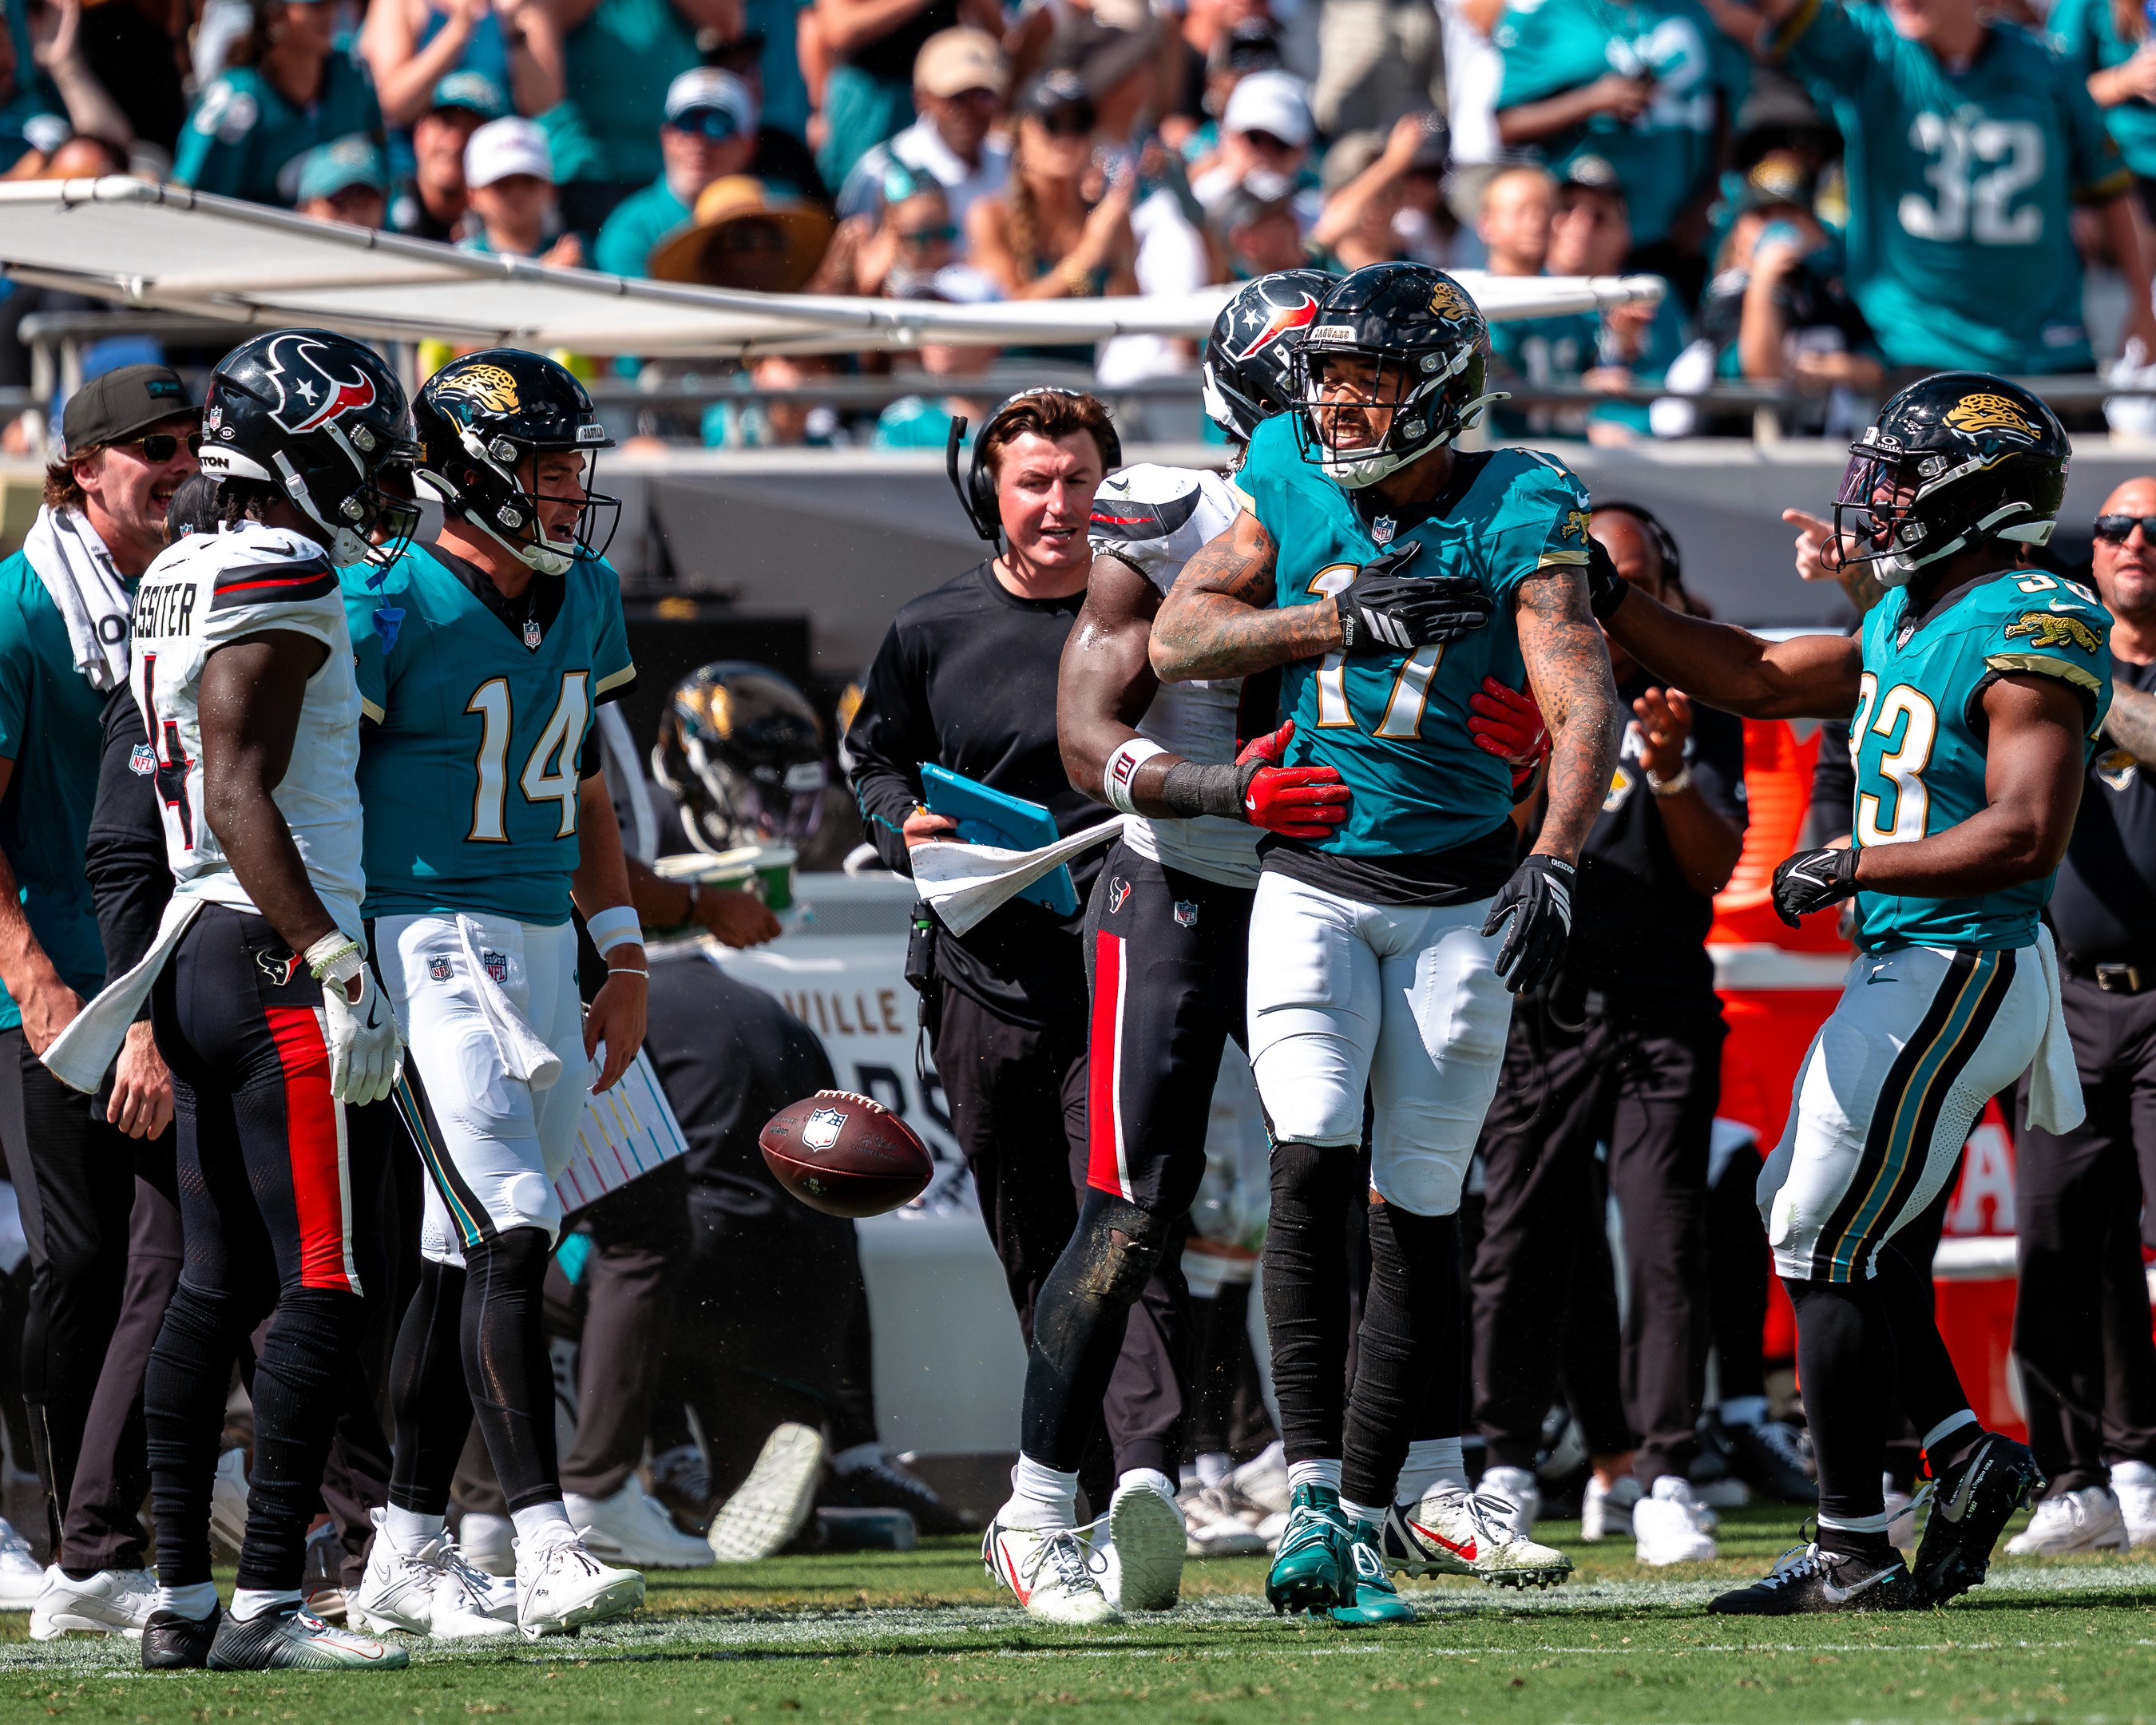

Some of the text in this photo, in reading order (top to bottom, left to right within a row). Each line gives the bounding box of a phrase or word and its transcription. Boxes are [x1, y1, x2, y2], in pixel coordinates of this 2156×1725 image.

[1898, 110, 2046, 245] 32
[1314, 327, 1349, 339] JAGUARS
[1374, 526, 1391, 540] NFL
[1345, 613, 1354, 646] ADIZERO
[526, 632, 541, 644] NFL
[131, 755, 154, 771] NFL
[462, 668, 591, 845] 14
[931, 767, 954, 781] Microsoft
[1551, 858, 1575, 874] ADIZERO
[1178, 910, 1195, 922] NFL
[487, 964, 505, 982] NFL
[1972, 1470, 1986, 1489] Oregon
[1984, 1458, 1995, 1470] USA
